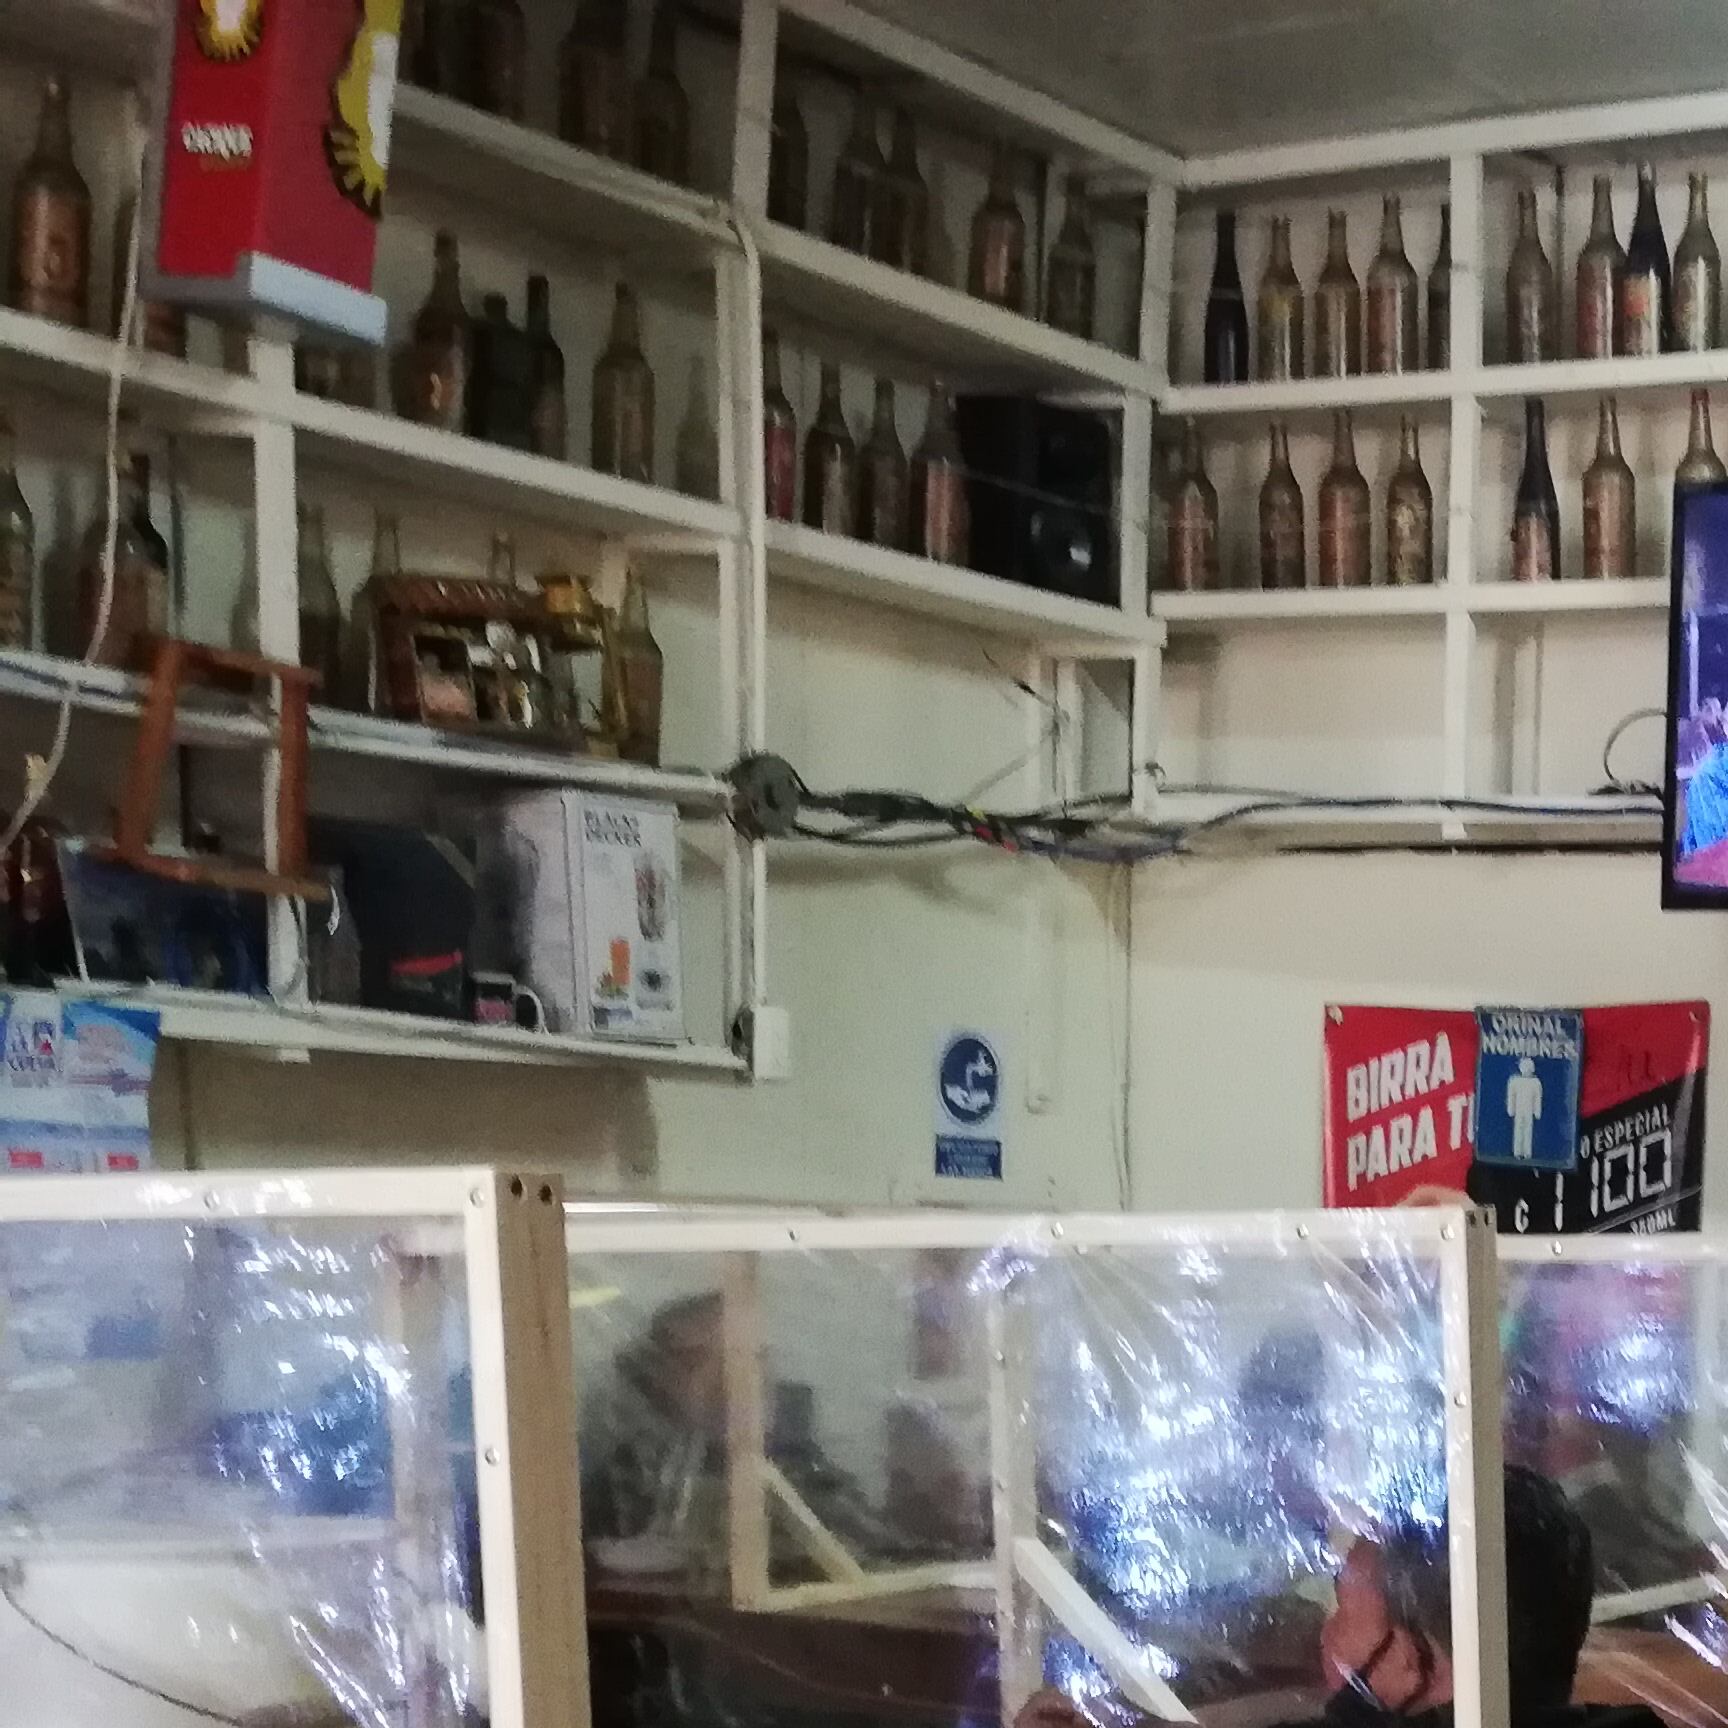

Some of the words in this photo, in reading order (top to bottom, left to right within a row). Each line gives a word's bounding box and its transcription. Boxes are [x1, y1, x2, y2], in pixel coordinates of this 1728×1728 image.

[1347, 1031, 1454, 1122] BIRRA
[1347, 1104, 1438, 1192] PARA
[1594, 1103, 1671, 1154] ESPECIAL
